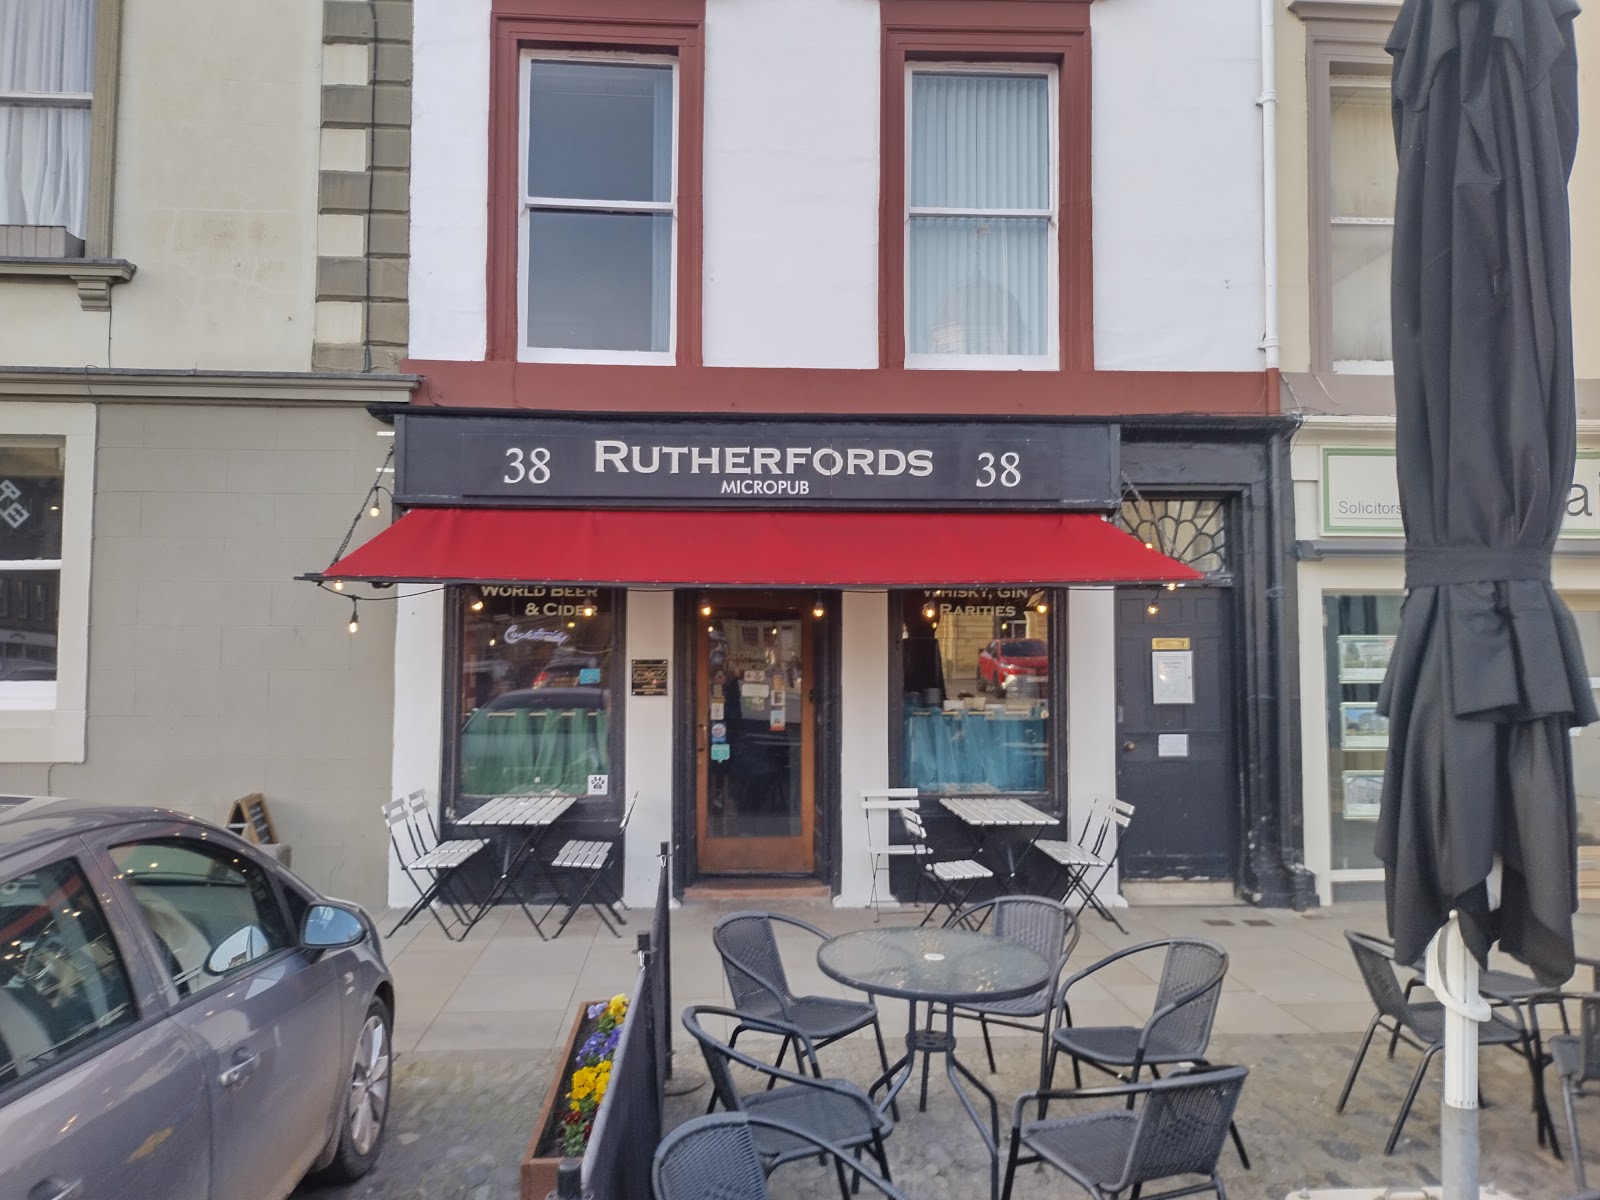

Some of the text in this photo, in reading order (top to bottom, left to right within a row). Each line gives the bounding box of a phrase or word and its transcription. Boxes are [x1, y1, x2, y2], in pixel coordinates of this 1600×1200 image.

[503, 447, 551, 484] 38
[594, 440, 934, 477] RUTHERFORDS
[975, 451, 1022, 488] 38
[720, 479, 810, 495] MICROPUB
[1339, 501, 1402, 514] Solicitors
[481, 585, 598, 597] WORLD BEER
[997, 588, 1028, 598] GIN
[525, 602, 540, 616] &
[940, 603, 1015, 616] RARITIES
